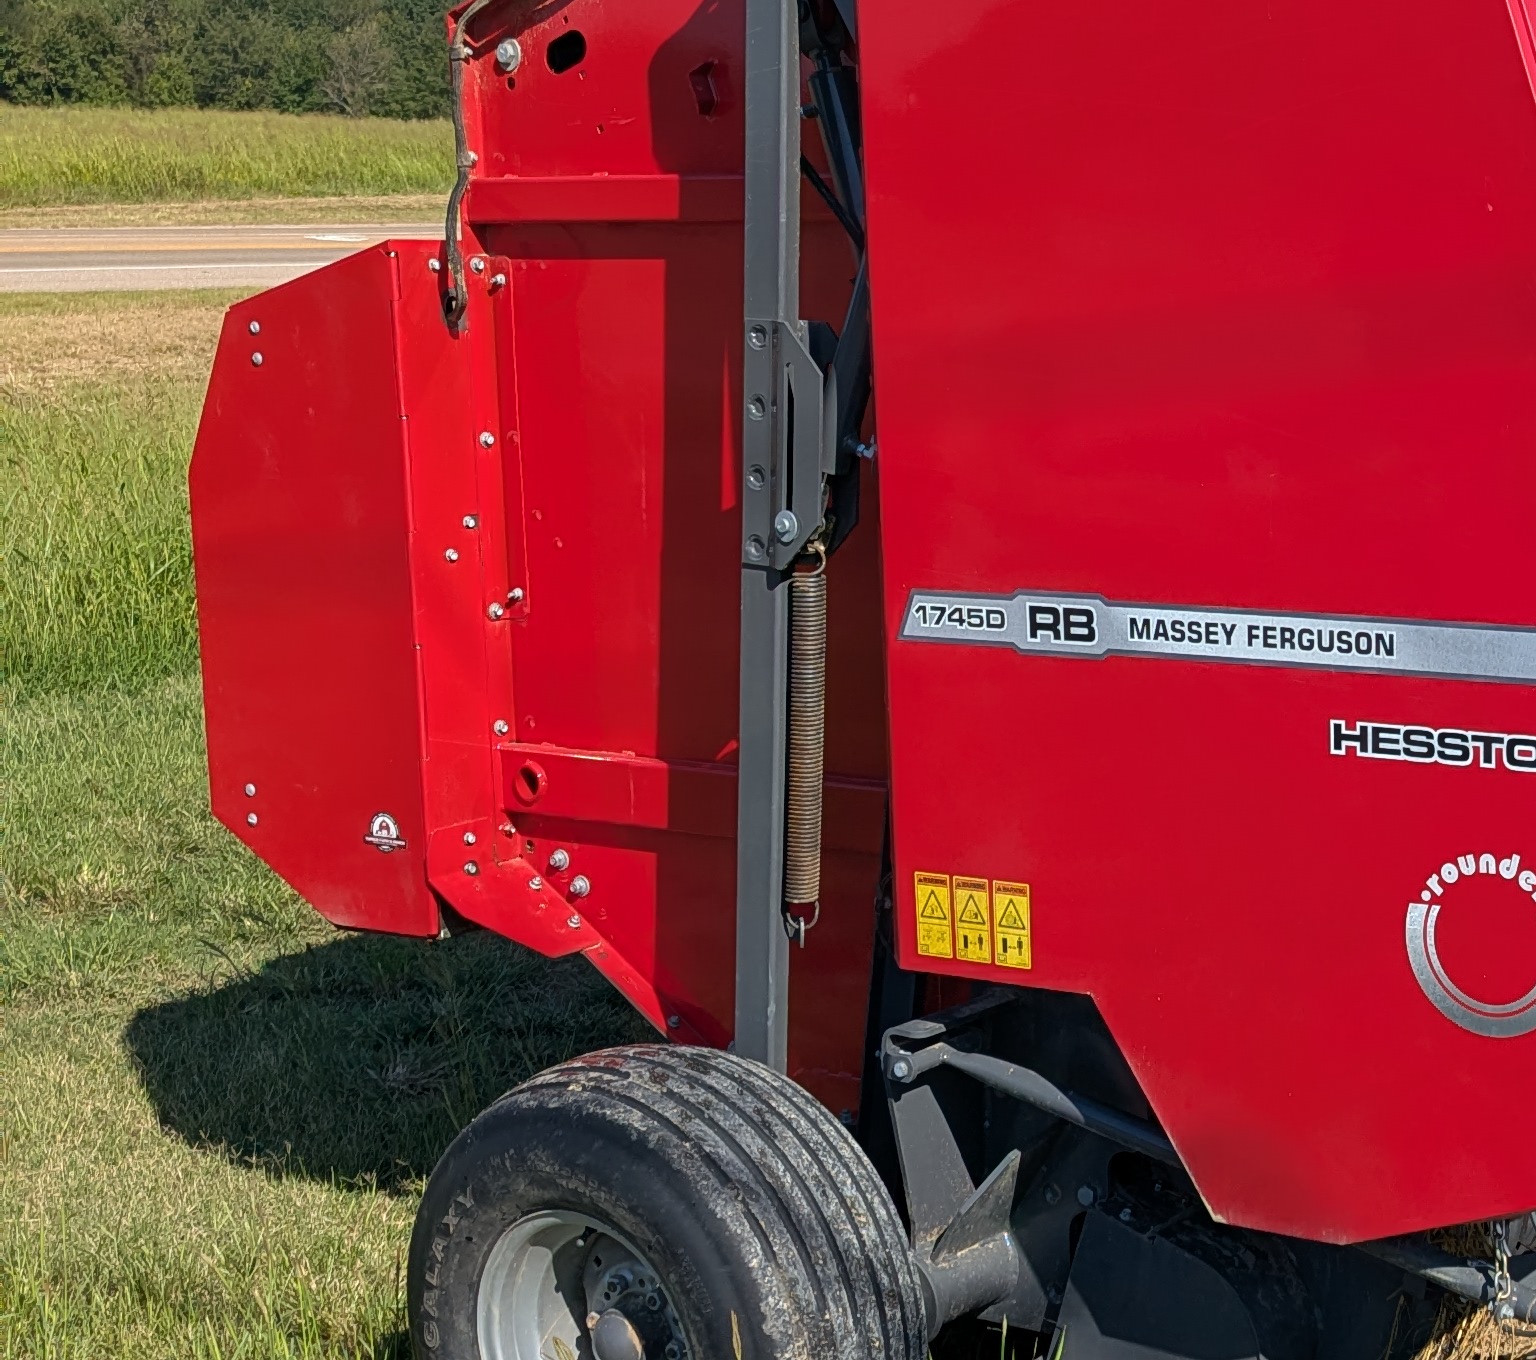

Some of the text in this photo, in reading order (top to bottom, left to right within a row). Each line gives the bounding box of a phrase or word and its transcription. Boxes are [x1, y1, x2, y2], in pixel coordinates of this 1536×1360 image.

[908, 602, 1395, 657] 1745D RB MASSEY FERGUSON
[423, 1185, 475, 1350] GALAXY
